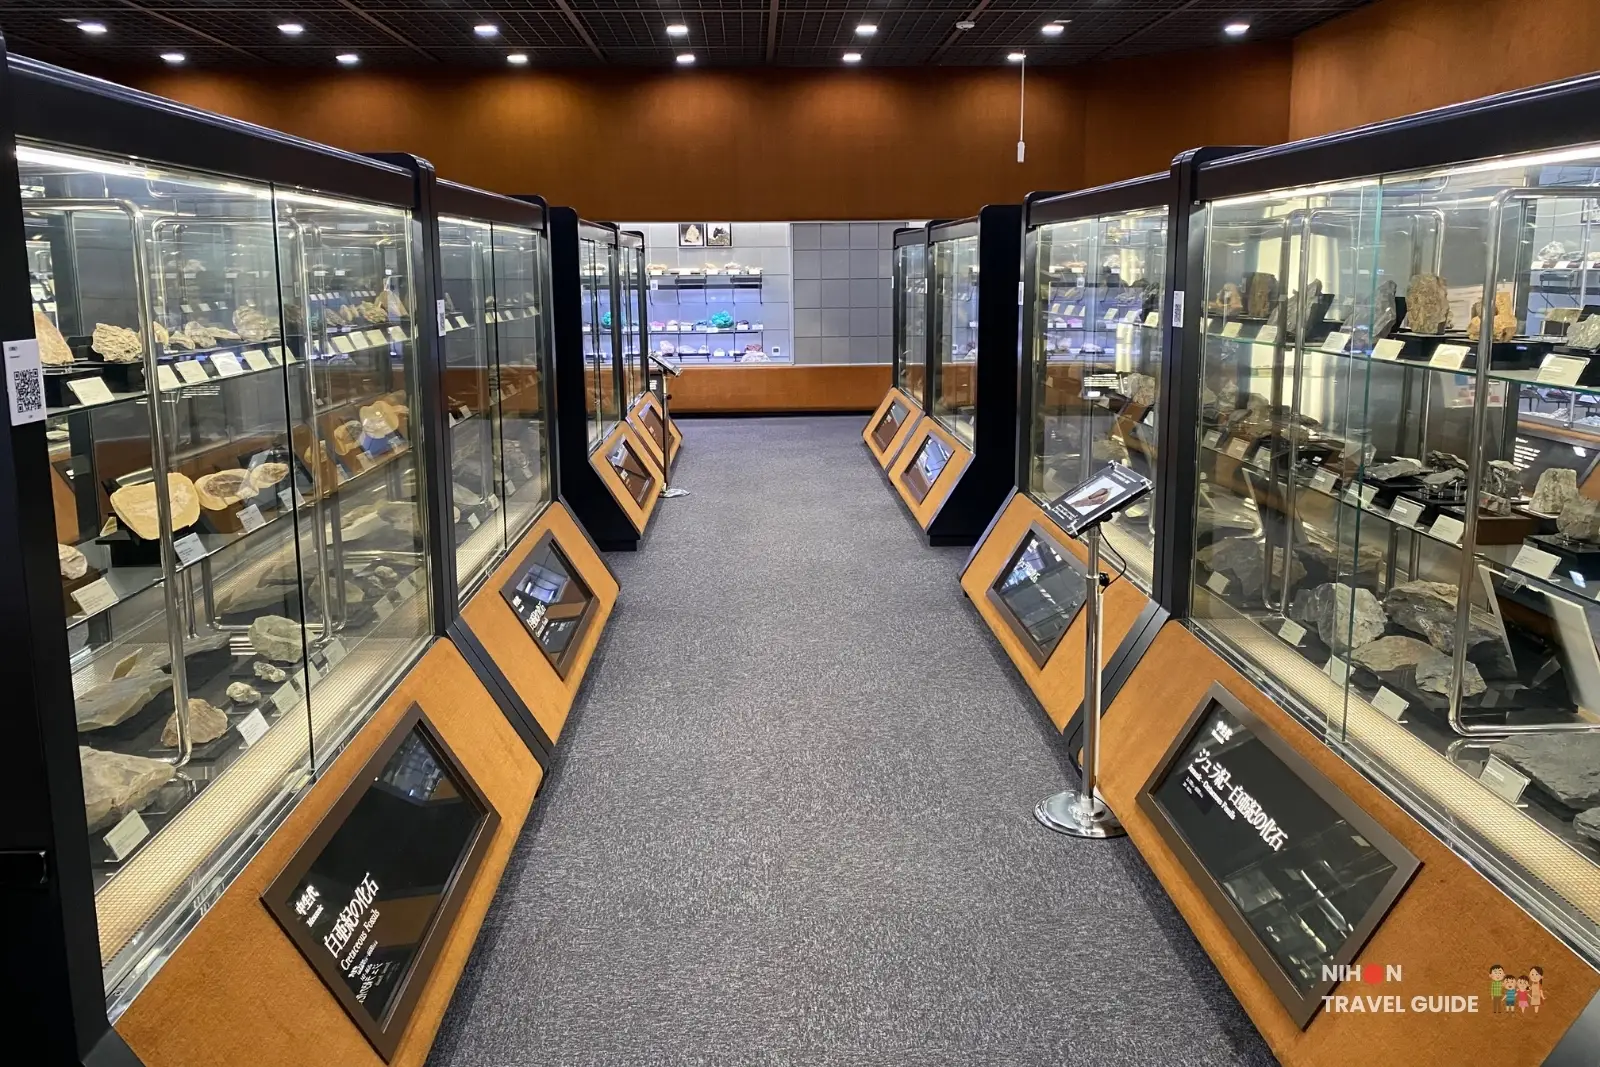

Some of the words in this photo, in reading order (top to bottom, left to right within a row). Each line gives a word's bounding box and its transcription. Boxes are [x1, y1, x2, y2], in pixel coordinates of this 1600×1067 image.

[295, 885, 320, 915] 中生代
[323, 872, 380, 959] 白亜紀の化石
[340, 929, 368, 971] Cretaceous
[363, 908, 380, 933] Fossils
